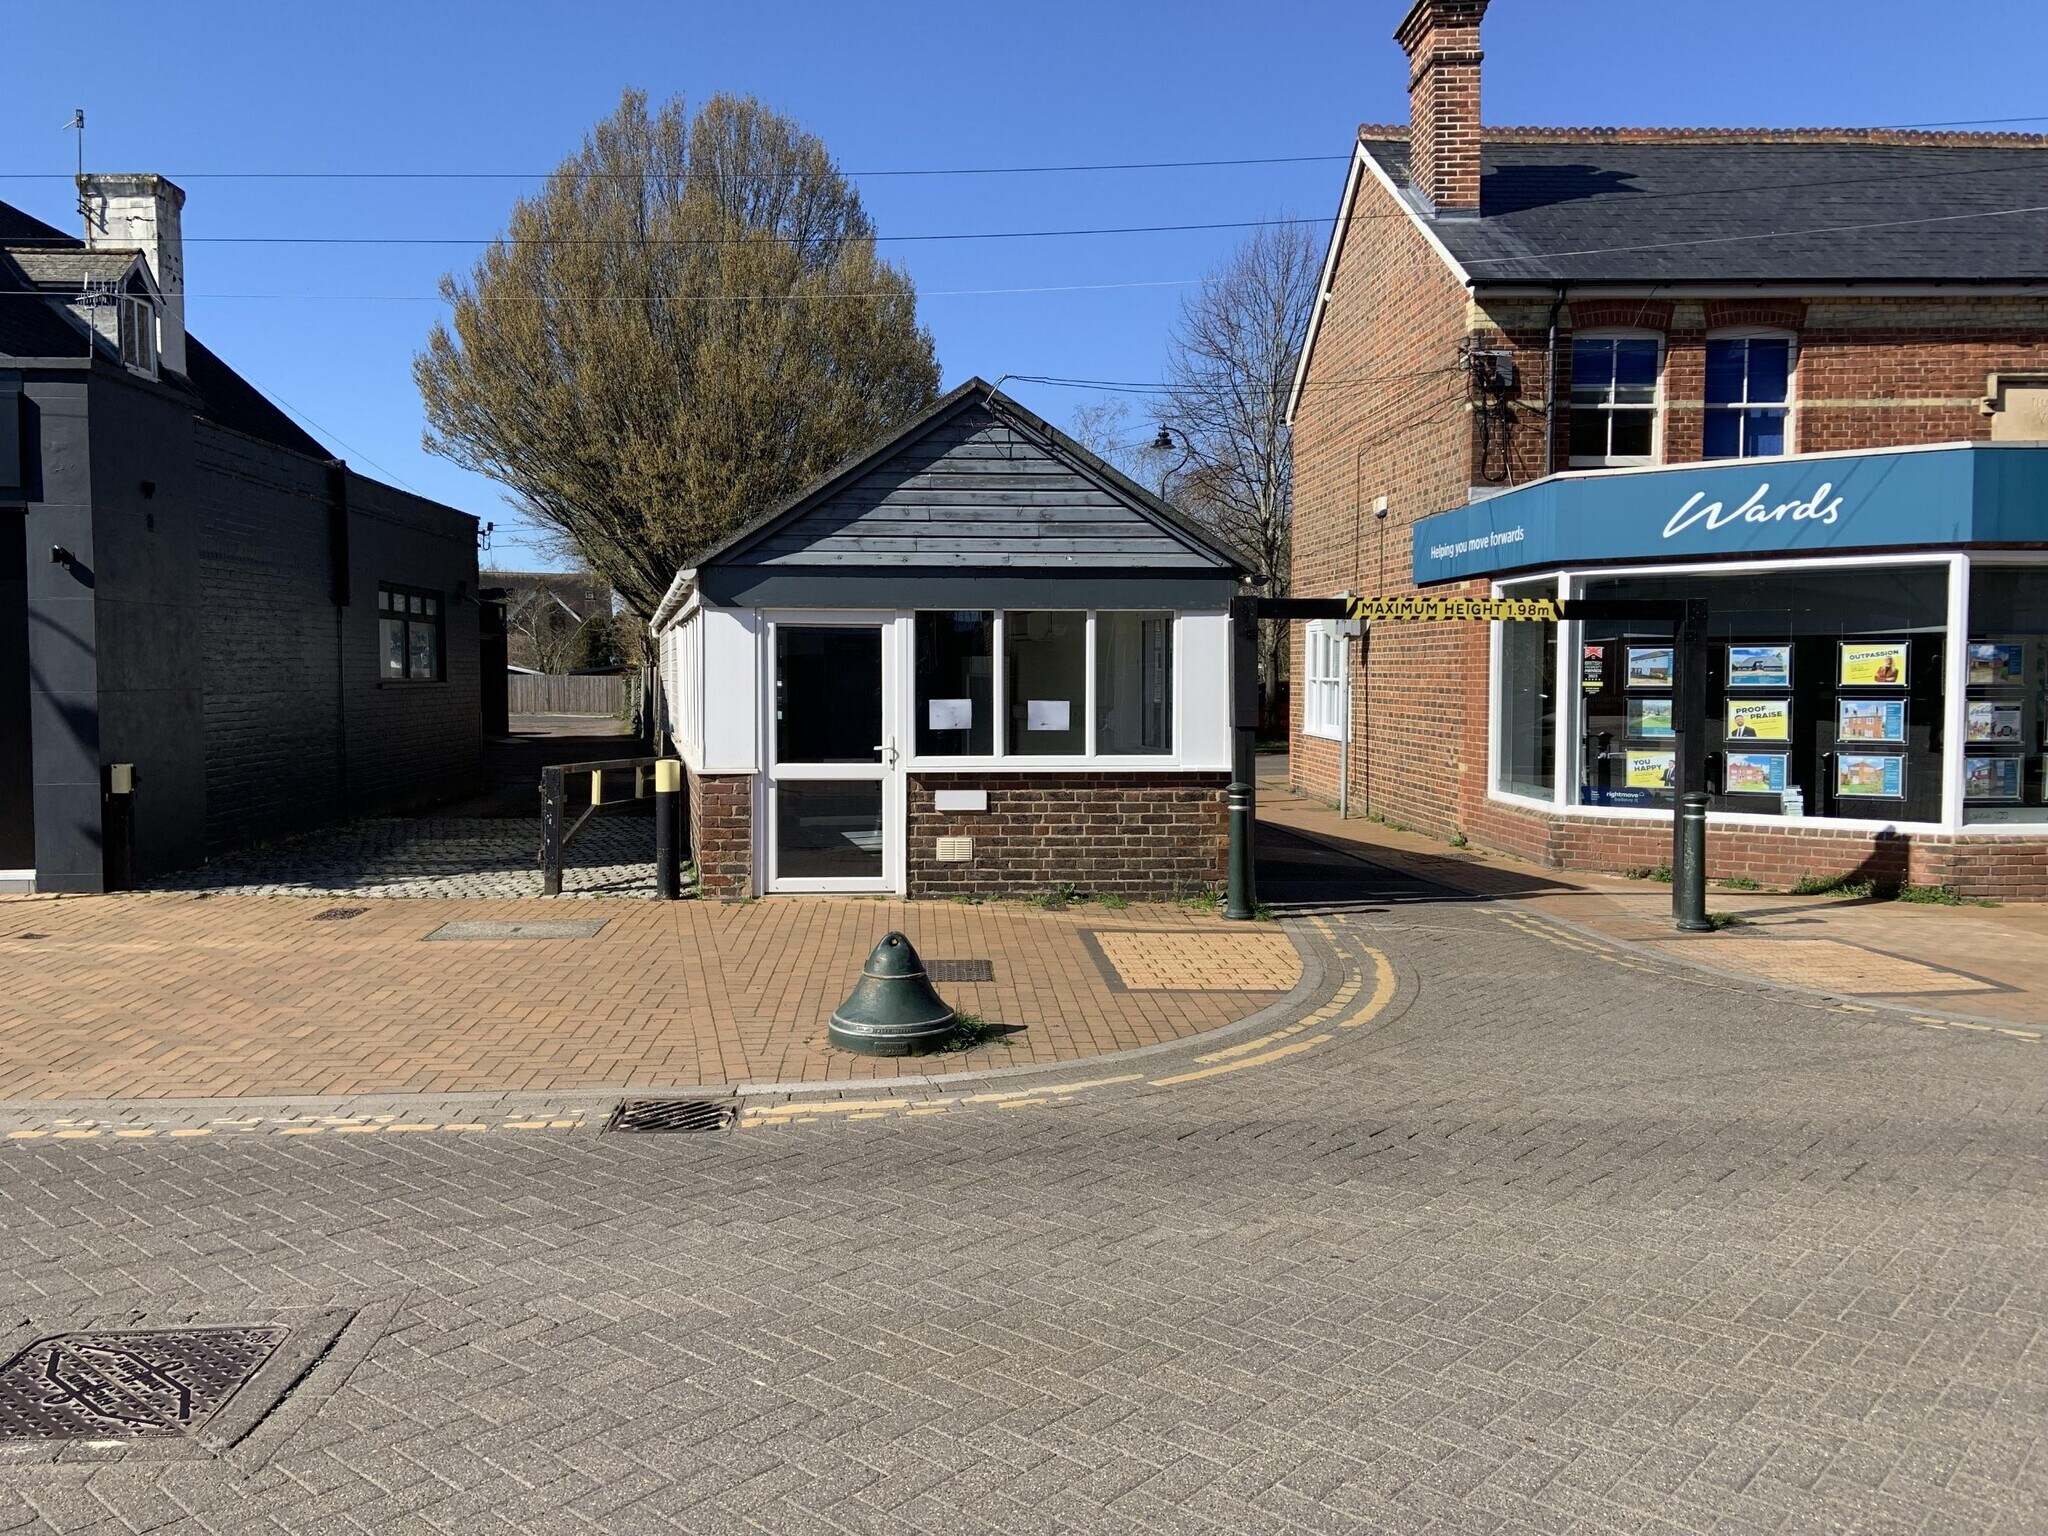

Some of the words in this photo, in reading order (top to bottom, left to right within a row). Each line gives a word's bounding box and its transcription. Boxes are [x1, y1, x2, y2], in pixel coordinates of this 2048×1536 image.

[1662, 482, 1844, 539] Wards
[1430, 543, 1454, 560] Helping
[1455, 540, 1468, 557] you
[1468, 536, 1489, 551] move
[1490, 525, 1525, 547] forwards
[1361, 602, 1438, 615] MAXIMUM
[1444, 603, 1503, 616] HEIGHT
[1507, 604, 1550, 616] 1.98m
[1849, 649, 1899, 661] OUTPASSION
[1735, 705, 1767, 714] PROOF
[1750, 711, 1784, 720] PRAISE
[1633, 758, 1651, 766] YOU
[1634, 764, 1662, 772] HAPPY
[1606, 791, 1639, 799] rightmove
